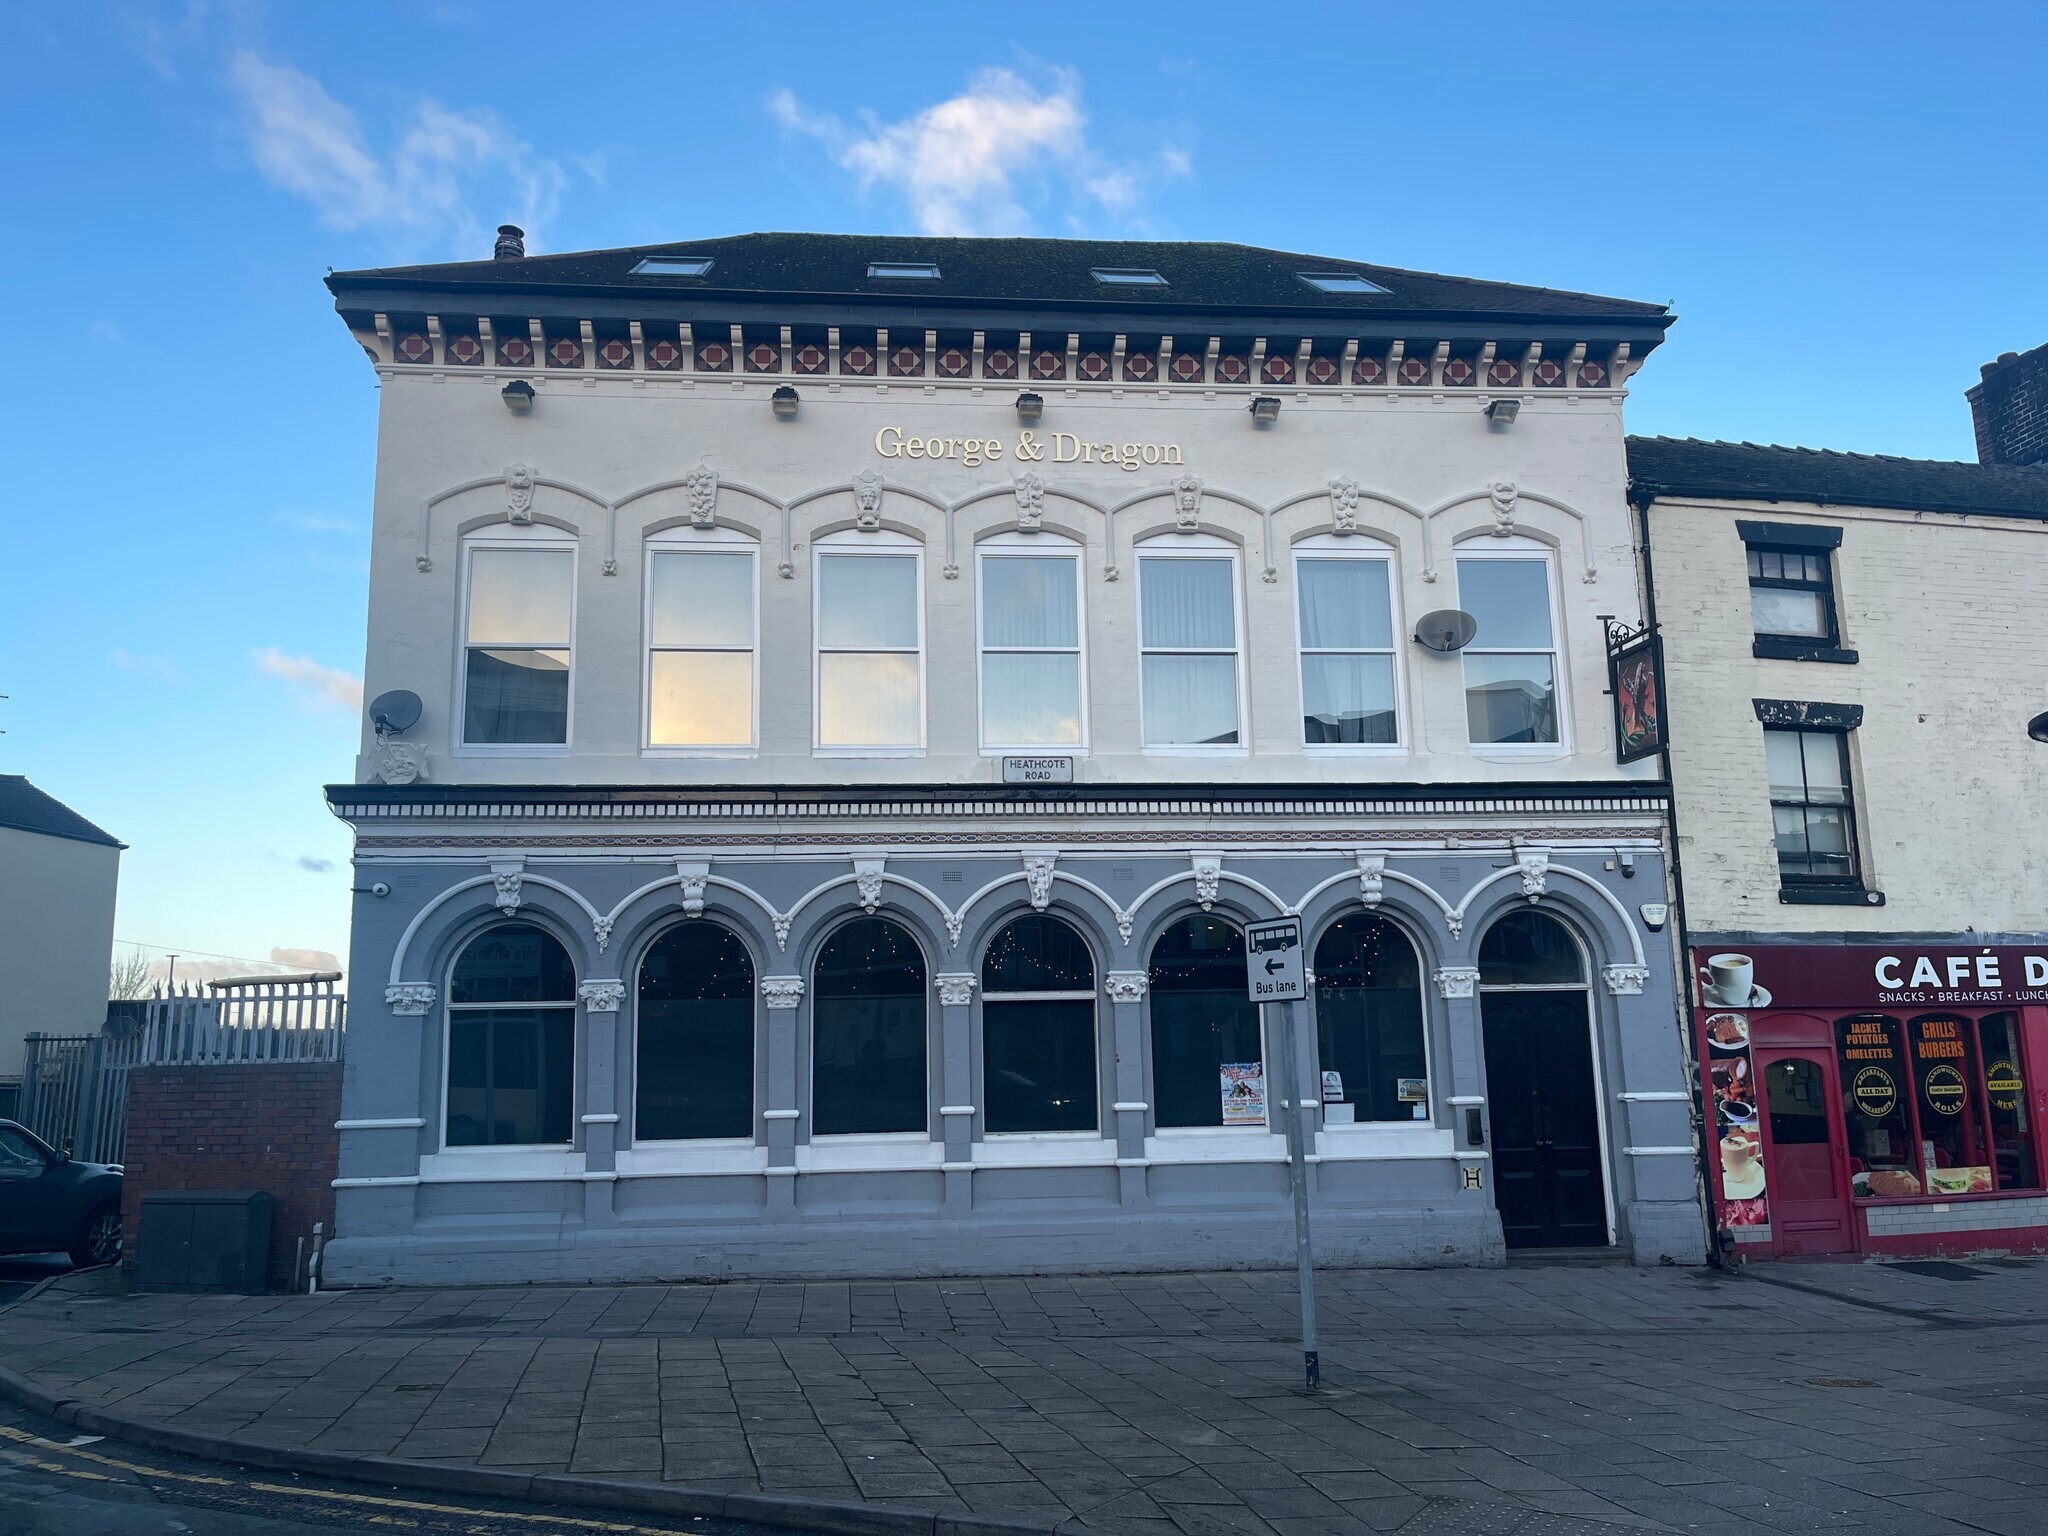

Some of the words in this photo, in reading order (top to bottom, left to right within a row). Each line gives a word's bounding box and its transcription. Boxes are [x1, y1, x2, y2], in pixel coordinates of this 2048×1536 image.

[875, 426, 1003, 467] George
[1014, 430, 1045, 461] &
[1052, 432, 1185, 472] Dragon
[1010, 759, 1066, 769] HEATHCOTE
[1025, 771, 1051, 780] ROAD
[1874, 948, 2002, 989] CAFÉ
[1256, 981, 1273, 994] Bus
[1275, 980, 1296, 993] lane
[1878, 991, 1926, 1003] SNACKS
[1938, 990, 2004, 1002] BREAKFAST
[1851, 1023, 1881, 1034] JACKET
[1922, 1021, 1956, 1039] GRILLS
[1846, 1034, 1889, 1045] POTATOES
[1845, 1048, 1893, 1060] OMELETTES
[1918, 1041, 1965, 1059] BURGERS
[1929, 1067, 1961, 1083] SANDWICHES
[1934, 1100, 1961, 1111] ROLLS
